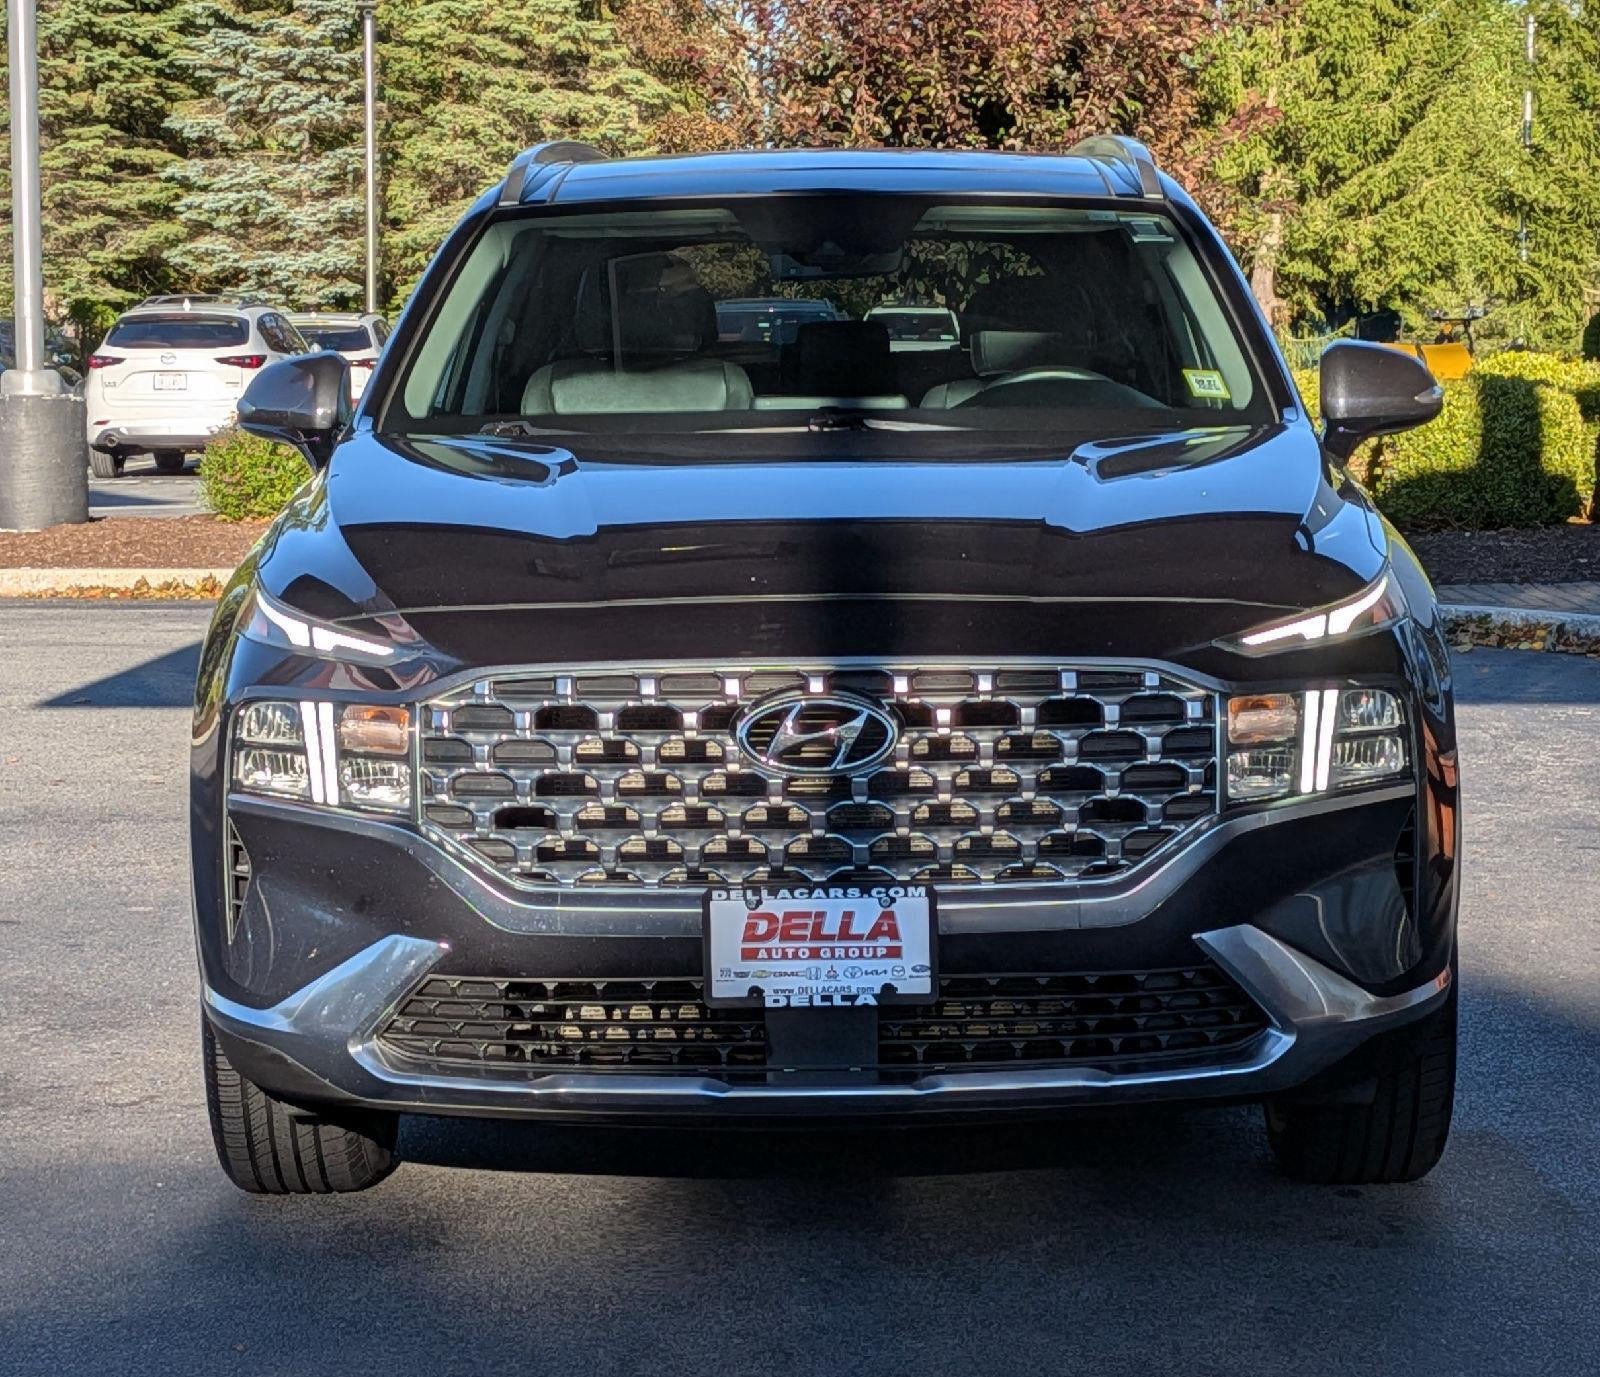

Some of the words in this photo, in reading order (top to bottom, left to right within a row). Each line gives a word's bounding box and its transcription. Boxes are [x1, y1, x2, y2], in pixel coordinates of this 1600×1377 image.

[712, 887, 926, 900] DELLACARS.COM
[742, 910, 902, 943] DELLA
[757, 948, 810, 959] AUTO
[820, 948, 888, 959] GROUP
[765, 995, 878, 1007] DELLA
